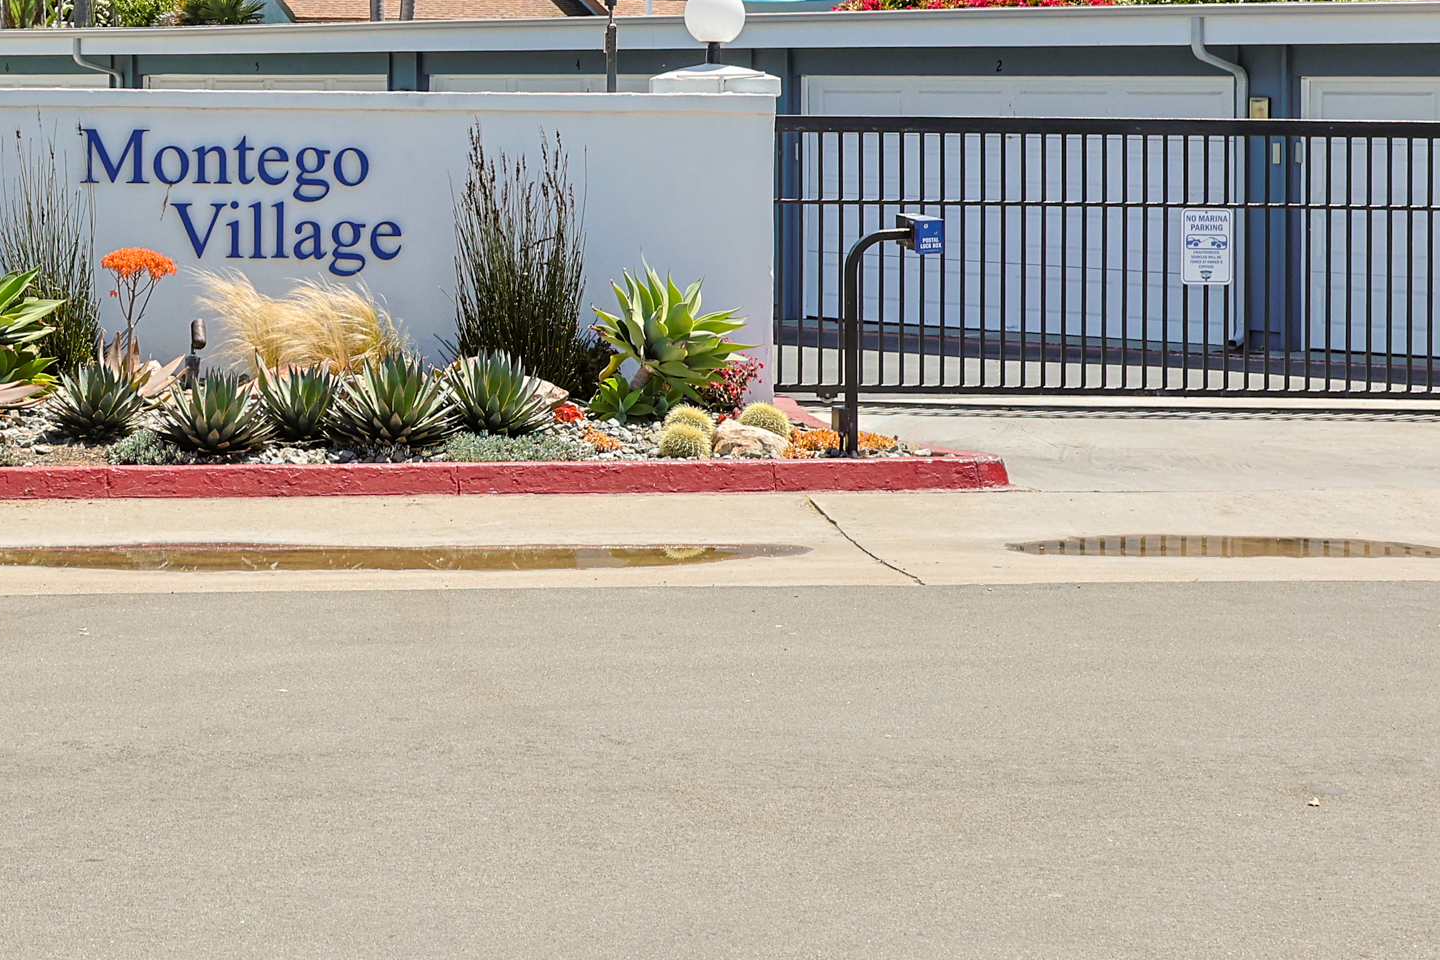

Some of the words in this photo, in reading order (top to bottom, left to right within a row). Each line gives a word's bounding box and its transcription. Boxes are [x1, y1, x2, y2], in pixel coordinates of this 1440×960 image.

[996, 59, 1003, 72] 2
[79, 128, 370, 202] Montego
[170, 200, 402, 277] Village
